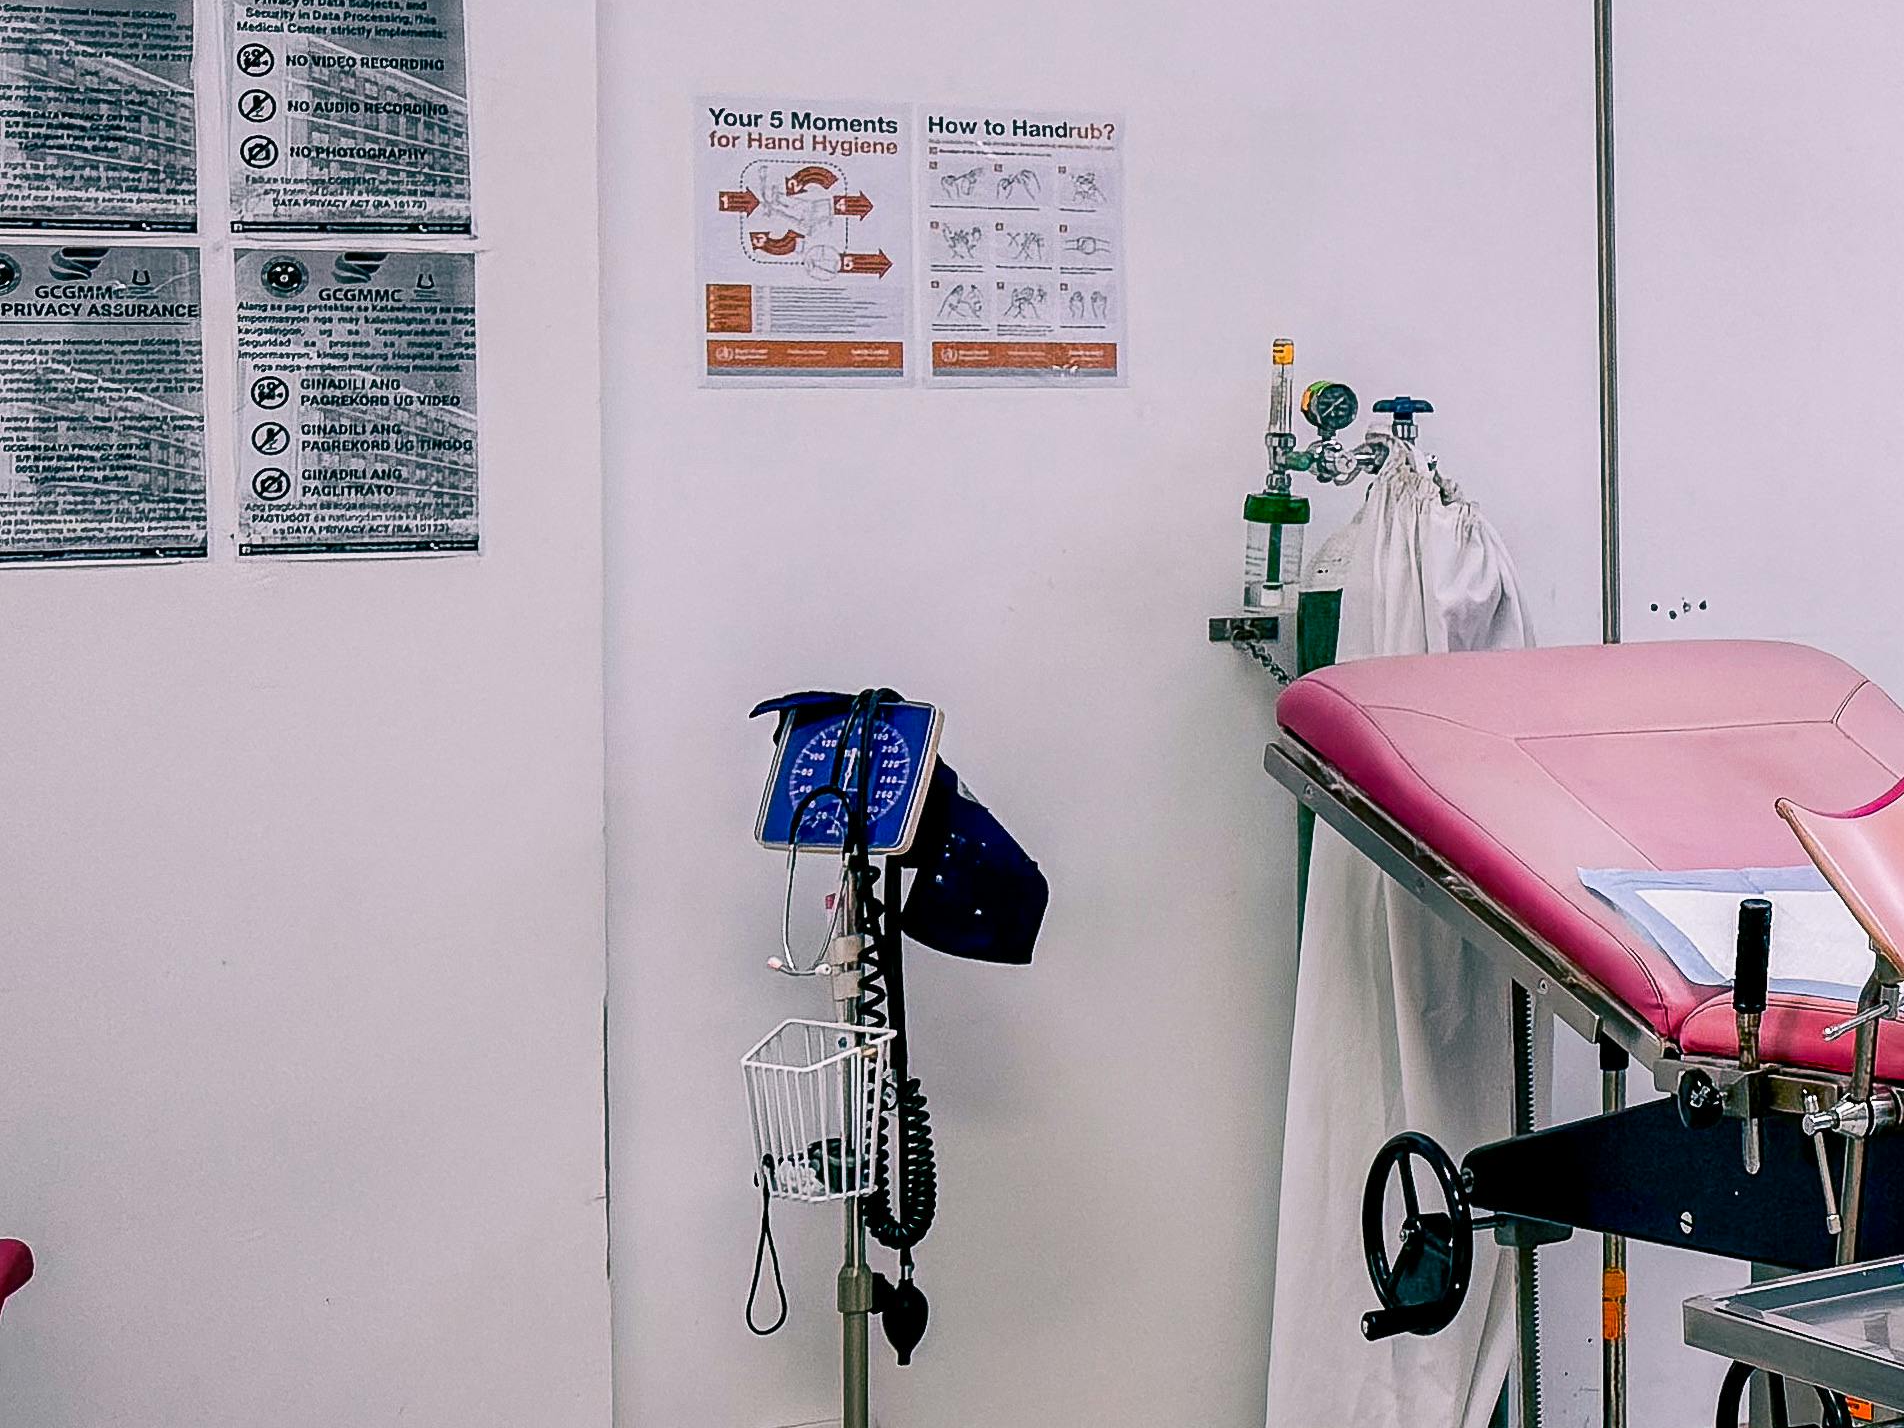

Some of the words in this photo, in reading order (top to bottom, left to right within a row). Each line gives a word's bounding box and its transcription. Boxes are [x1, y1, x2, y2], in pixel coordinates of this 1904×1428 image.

[406, 0, 427, 10] and
[246, 7, 295, 20] Security
[299, 9, 309, 20] in
[313, 10, 340, 21] Data
[237, 21, 284, 33] Medical
[288, 23, 327, 35] Center
[331, 24, 372, 39] strictly
[286, 54, 308, 67] NO
[312, 55, 356, 69] VIDEO
[360, 56, 444, 71] RECORDING
[287, 100, 310, 113] NO
[314, 101, 360, 114] AUDIO
[364, 102, 448, 116] RECORDING
[709, 108, 763, 127] Your
[770, 111, 783, 129] 5
[791, 111, 898, 134] Moments
[928, 116, 977, 135] How
[984, 119, 1005, 136] to
[1013, 119, 1115, 141] Handrub?
[709, 130, 740, 148] for
[747, 132, 804, 151] Hand
[812, 135, 898, 156] Hygiene
[290, 146, 311, 158] NO
[315, 147, 427, 160] PHOTOGRAPHY
[788, 178, 801, 192] 2
[273, 198, 300, 208] DATA
[303, 198, 347, 209] PRIVACY
[350, 199, 370, 209] ACT
[721, 195, 729, 209] 1
[35, 285, 125, 300] GCGMMC
[319, 288, 403, 302] GCGMMC
[1, 302, 82, 316] PRIVACY
[87, 303, 198, 317] ASSURANCE
[301, 378, 366, 390] GINADILI
[369, 379, 401, 390] ANG
[301, 394, 389, 407] PAGREKORD
[394, 395, 414, 406] UG
[417, 395, 461, 407] VIDEO
[301, 423, 366, 436] GINADILI
[369, 424, 401, 435] ANG
[302, 439, 390, 451] PAGREKORD
[395, 440, 414, 451] UG
[419, 440, 473, 452] TINGOG
[301, 468, 366, 480] GINADILI
[370, 469, 401, 480] ANG
[302, 484, 394, 497] PAGLITRATO
[287, 525, 316, 535] DATA
[368, 525, 388, 534] ACT
